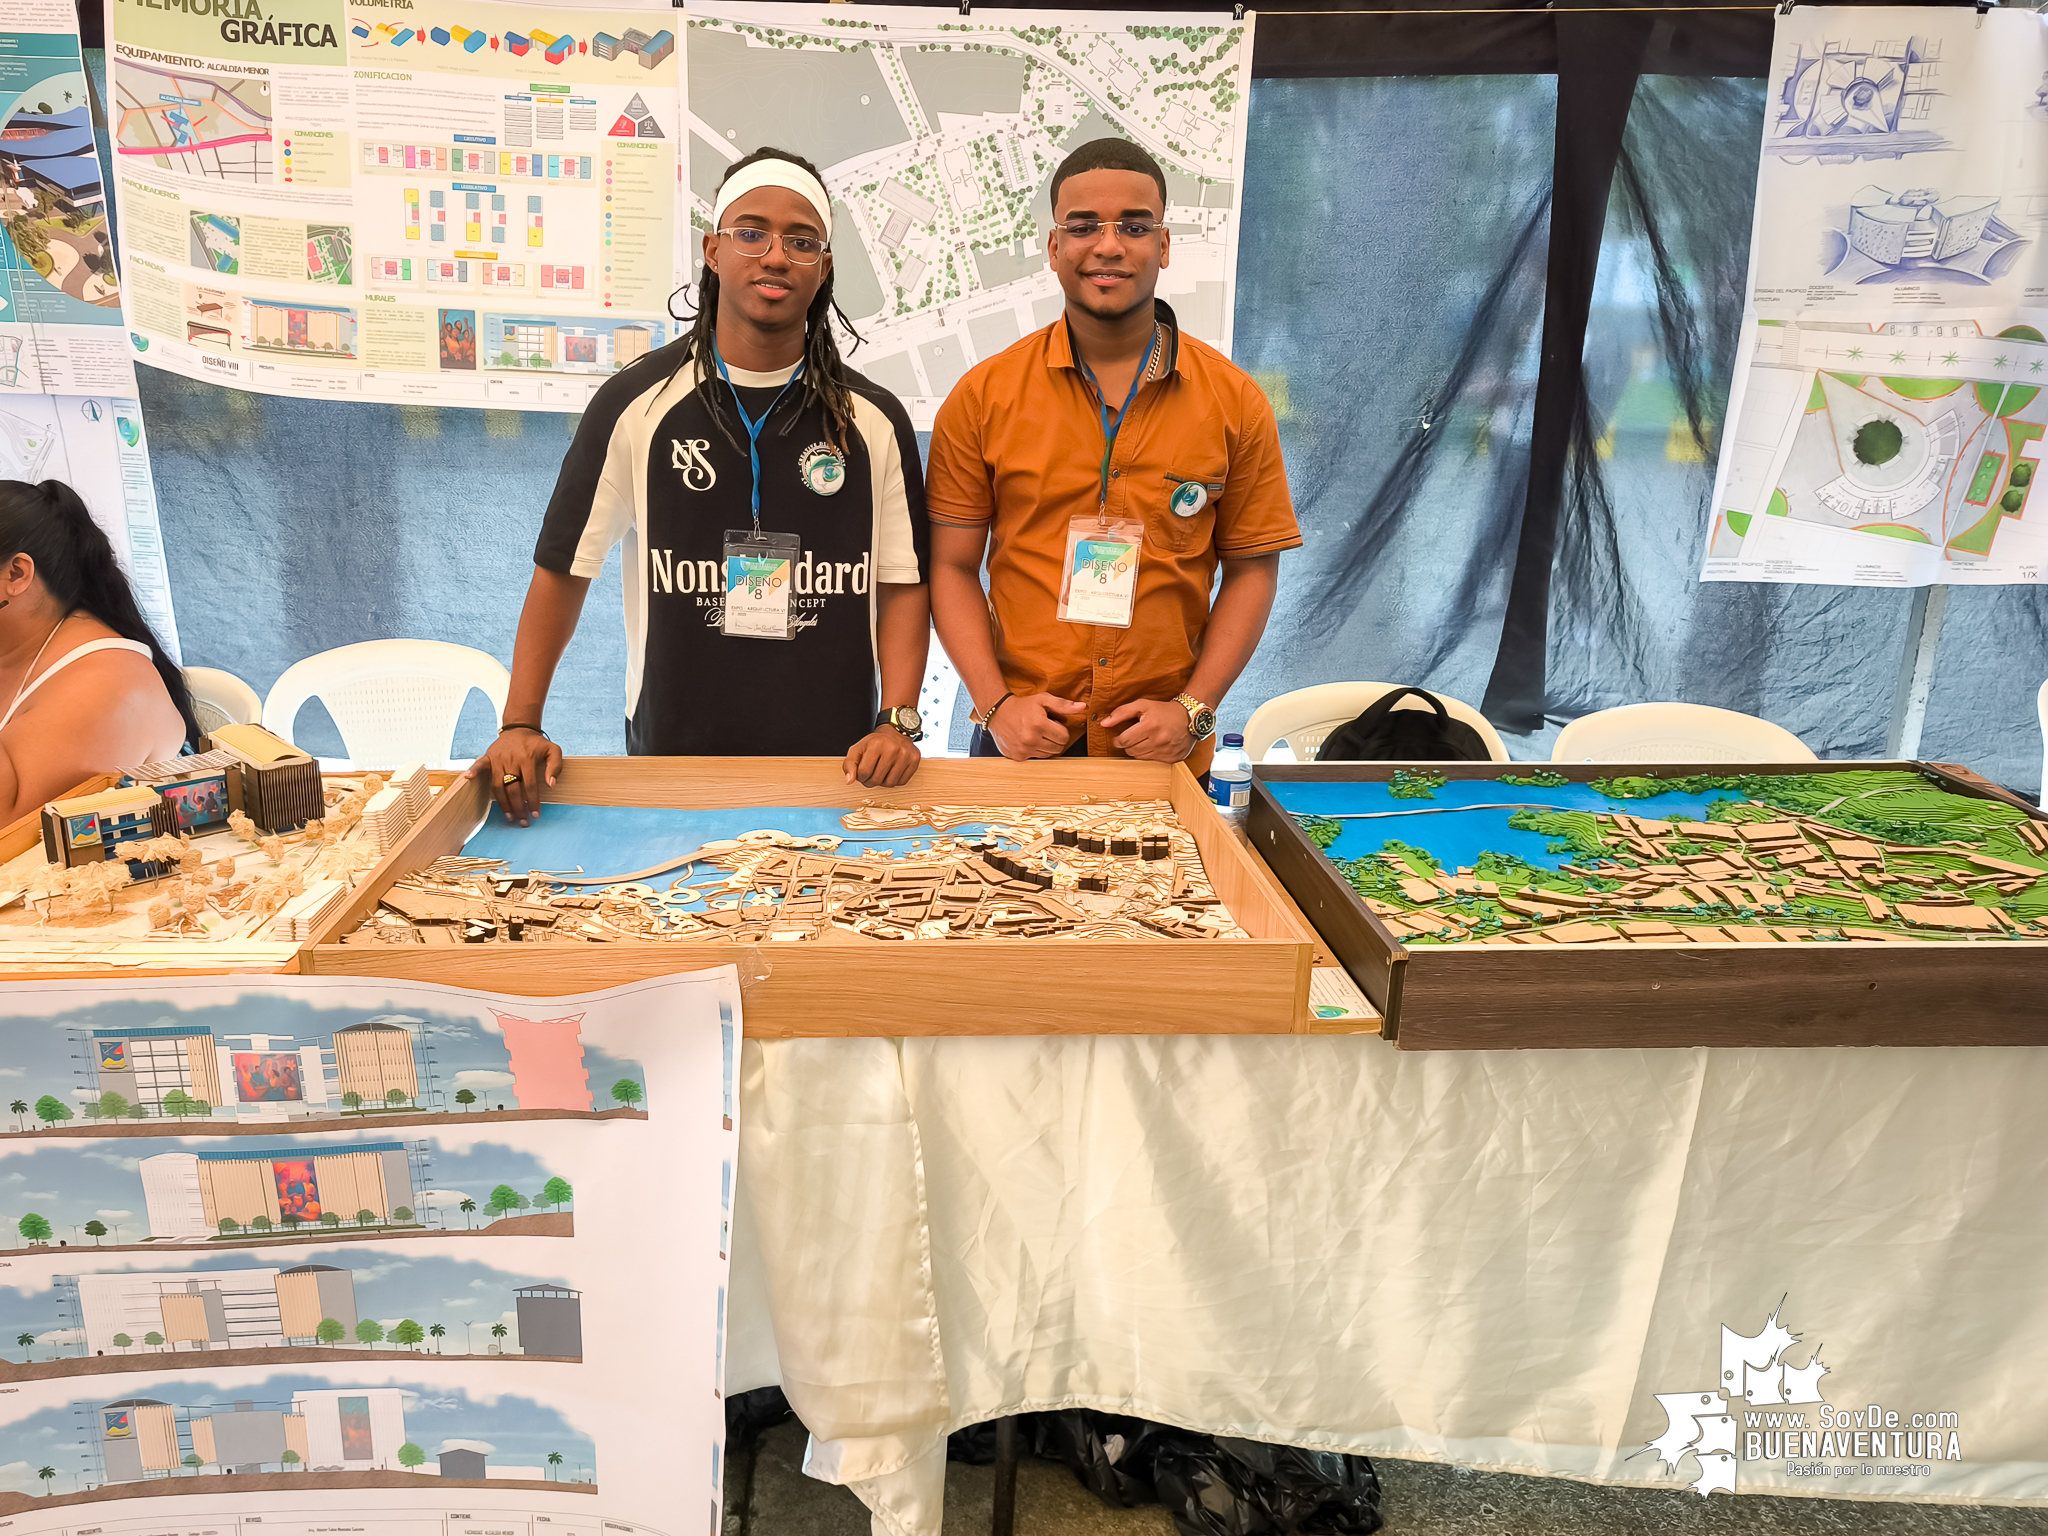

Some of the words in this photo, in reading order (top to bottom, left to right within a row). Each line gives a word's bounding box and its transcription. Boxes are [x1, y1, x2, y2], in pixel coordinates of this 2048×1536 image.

[220, 14, 338, 48] GRÁFICA
[116, 43, 205, 69] EQUIPAMIENTO:
[243, 67, 270, 76] MENOR
[354, 71, 412, 81] ZONIFICACION
[122, 177, 180, 201] PARQUEADEROS
[365, 294, 397, 303] MURALES
[650, 548, 868, 595] Nondard
[1082, 558, 1128, 573] DISEÑO
[735, 573, 783, 588] DISEÑO
[1099, 572, 1107, 585] 8
[754, 588, 763, 600] 8
